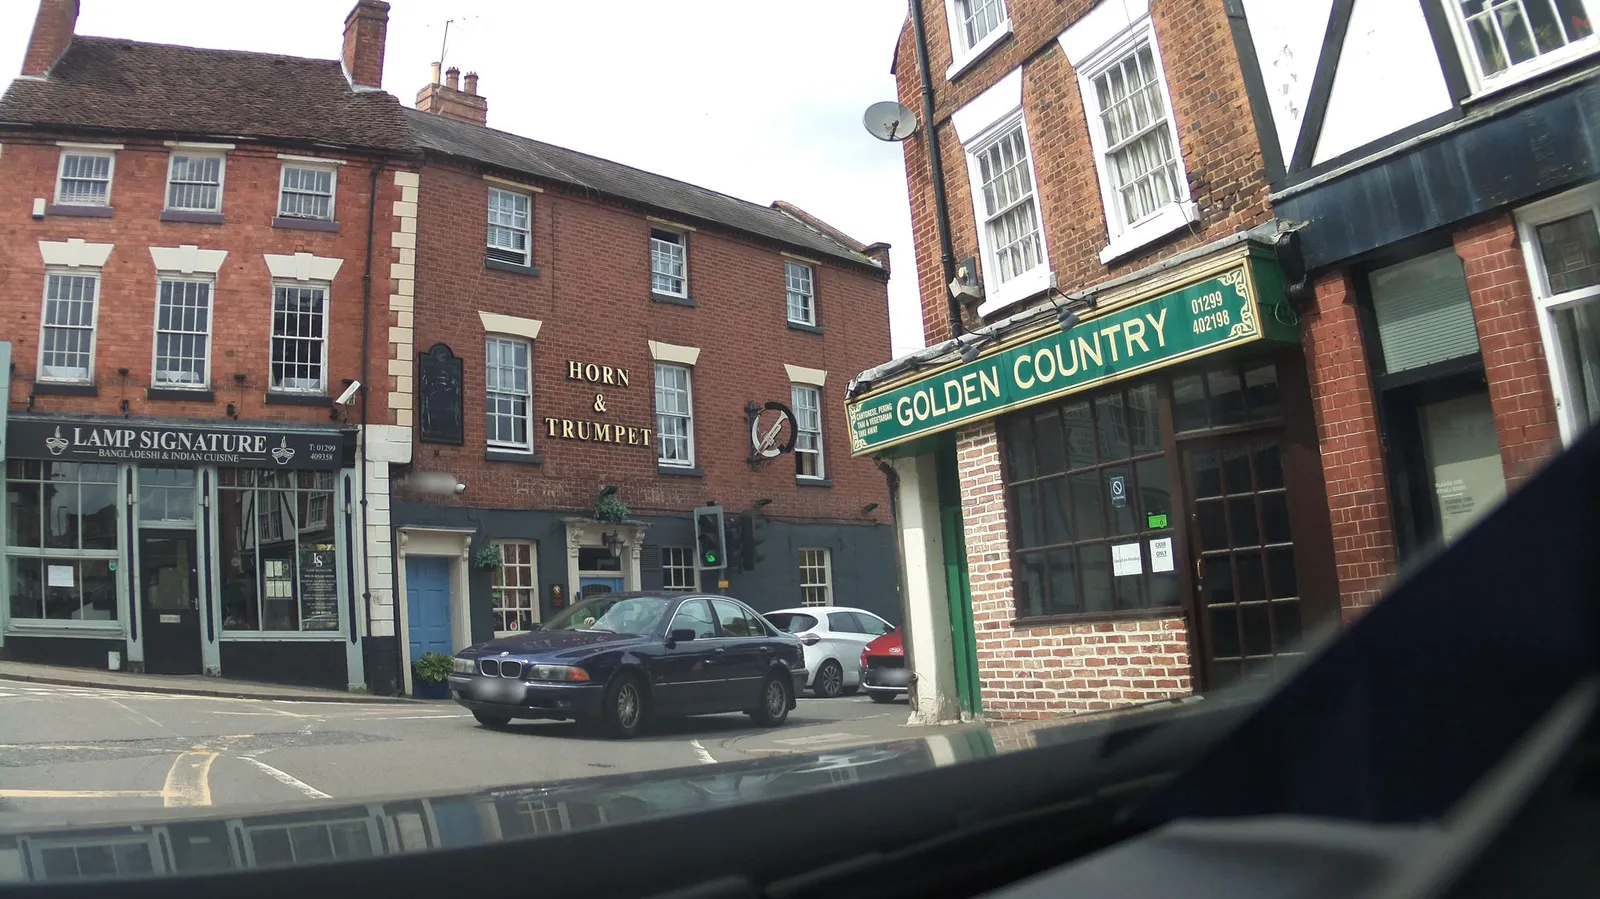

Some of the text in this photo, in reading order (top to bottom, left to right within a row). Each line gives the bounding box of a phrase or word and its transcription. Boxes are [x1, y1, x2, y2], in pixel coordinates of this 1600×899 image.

[1191, 291, 1223, 315] 01299
[1192, 309, 1230, 335] 402198
[568, 361, 630, 386] HORN
[896, 308, 1168, 427] GOLDEN COUNTRY
[593, 393, 607, 412] &
[73, 427, 267, 454] LAMP SIGNATURE
[545, 417, 652, 446] TRUMPET
[98, 448, 239, 463] BANGLADESHI & INDIAN CUISINE
[309, 443, 336, 452] T: 01299
